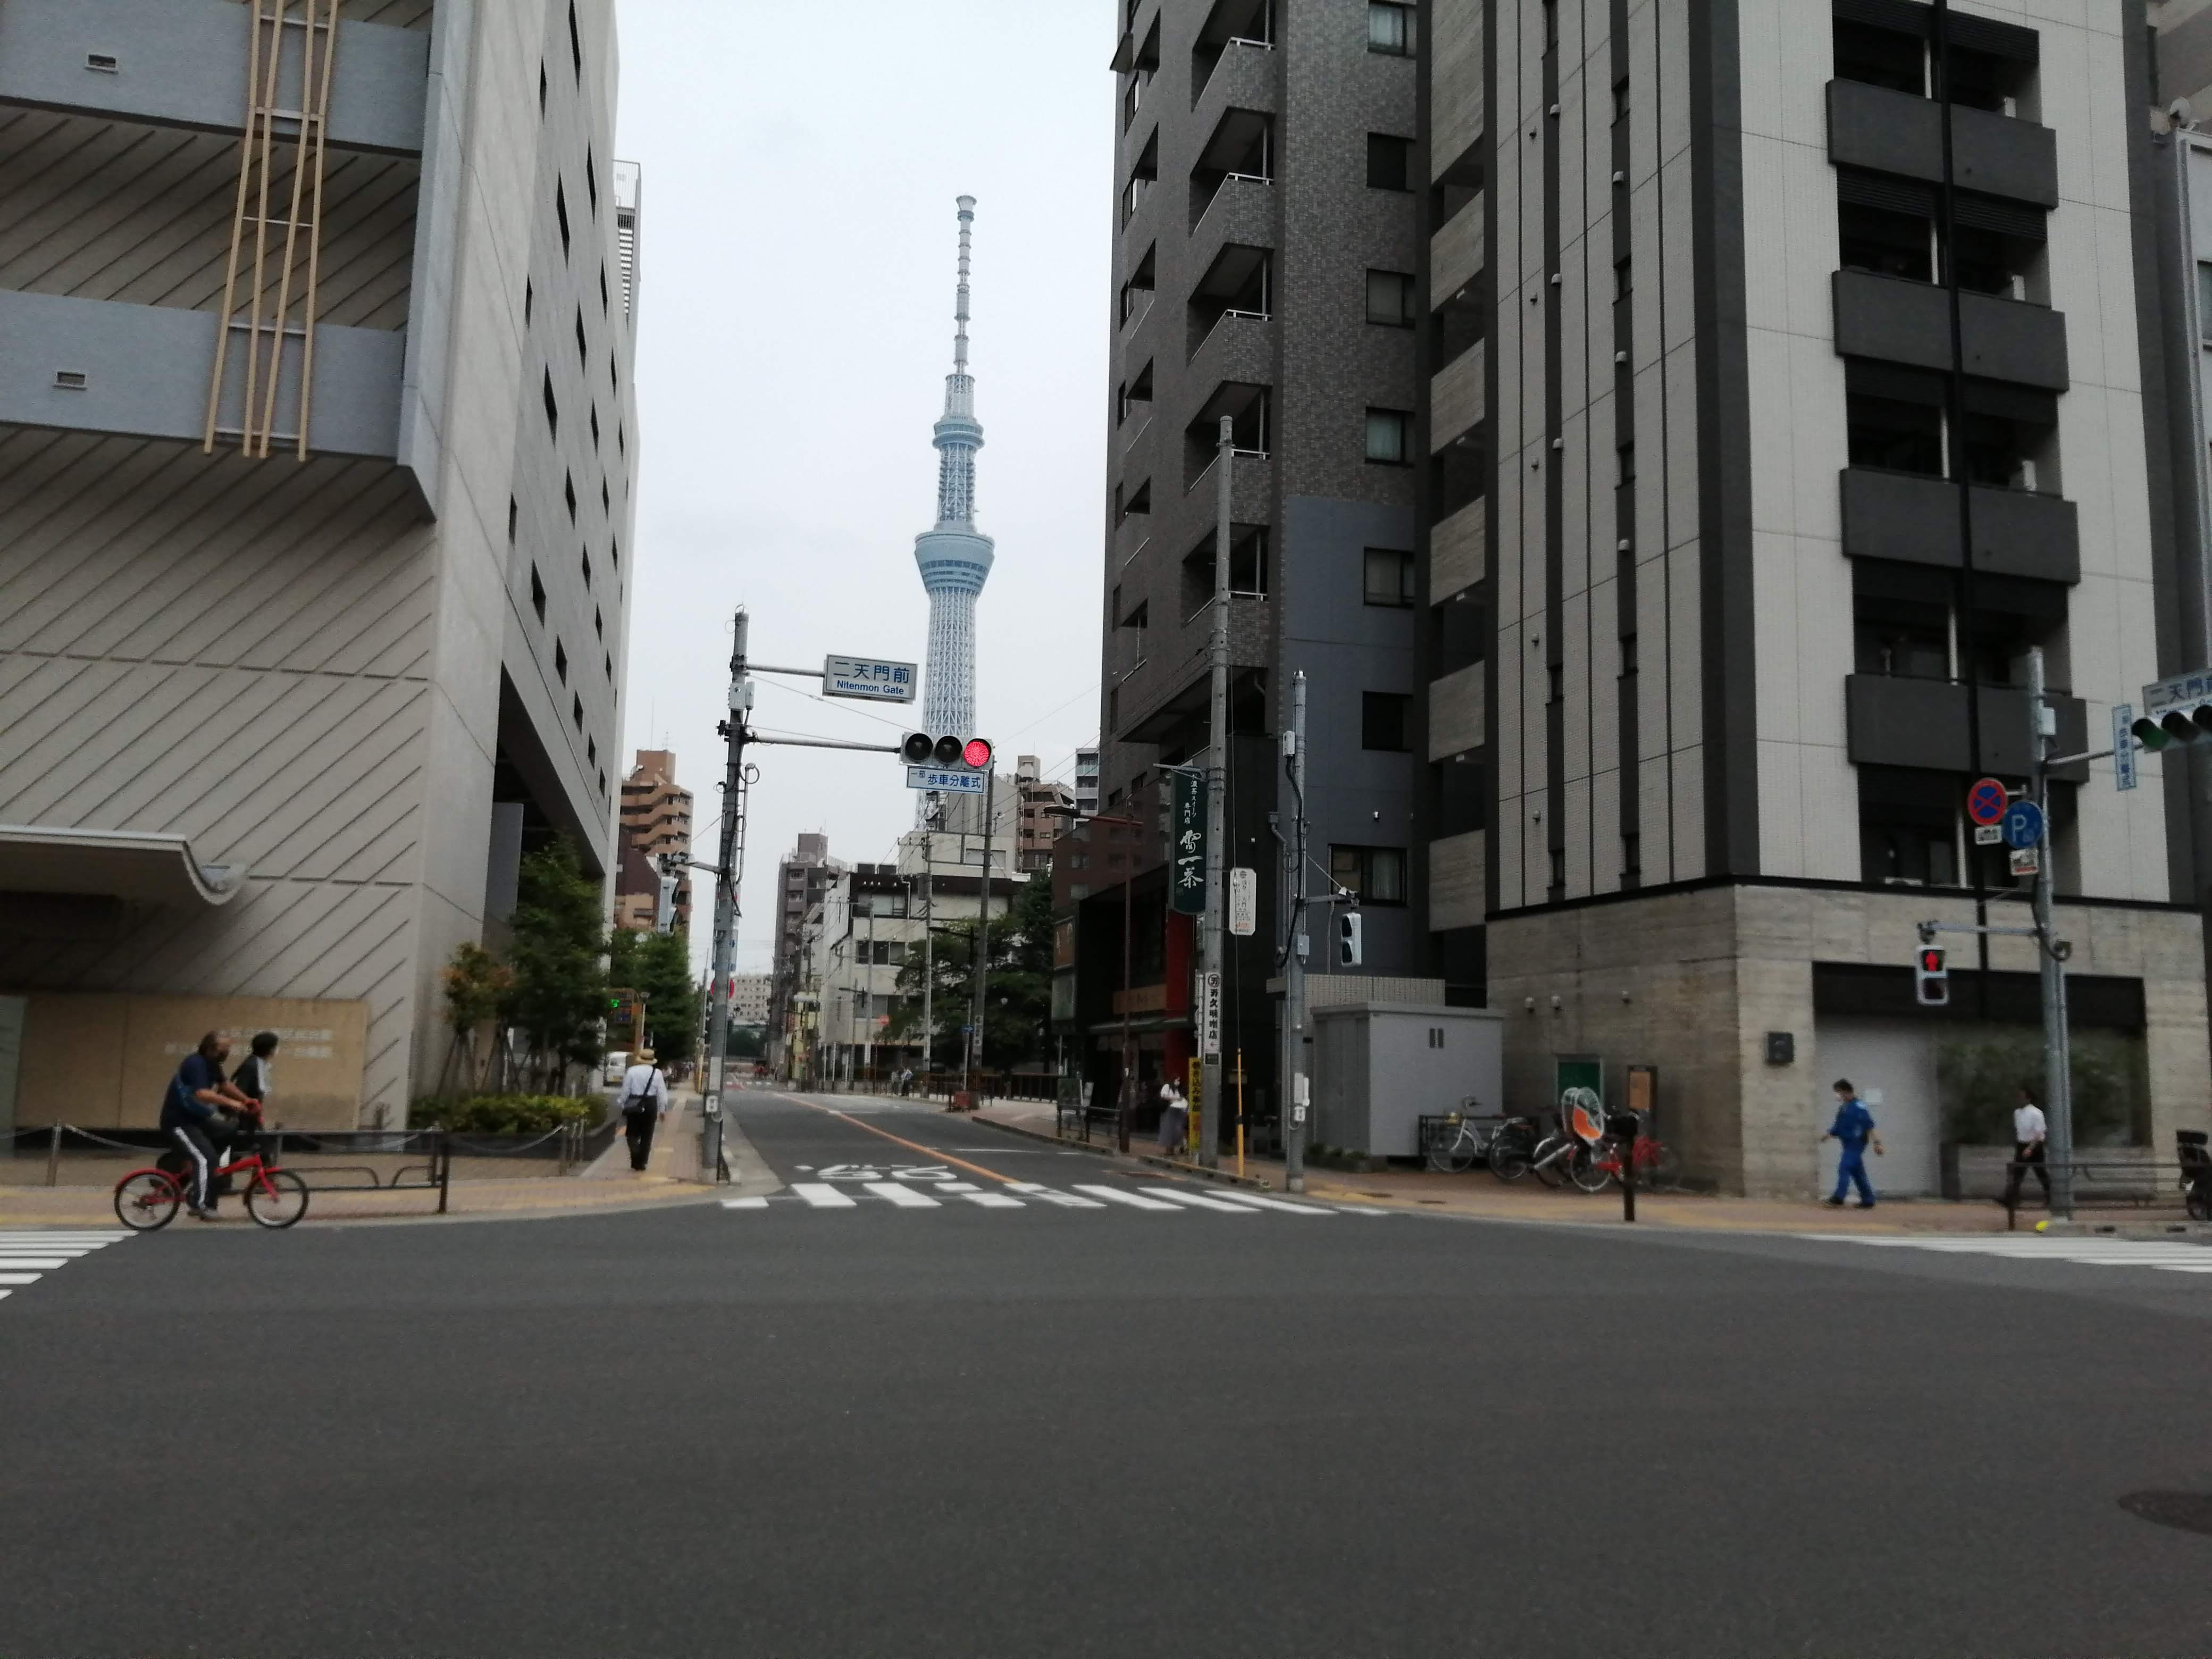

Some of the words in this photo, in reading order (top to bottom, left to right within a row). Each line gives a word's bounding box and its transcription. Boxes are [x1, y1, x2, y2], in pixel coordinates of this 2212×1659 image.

[834, 661, 909, 683] 二天門前
[837, 680, 878, 692] Nitenmon
[883, 685, 904, 694] Gate
[928, 774, 981, 788] 歩車分離式
[2012, 814, 2026, 842] P
